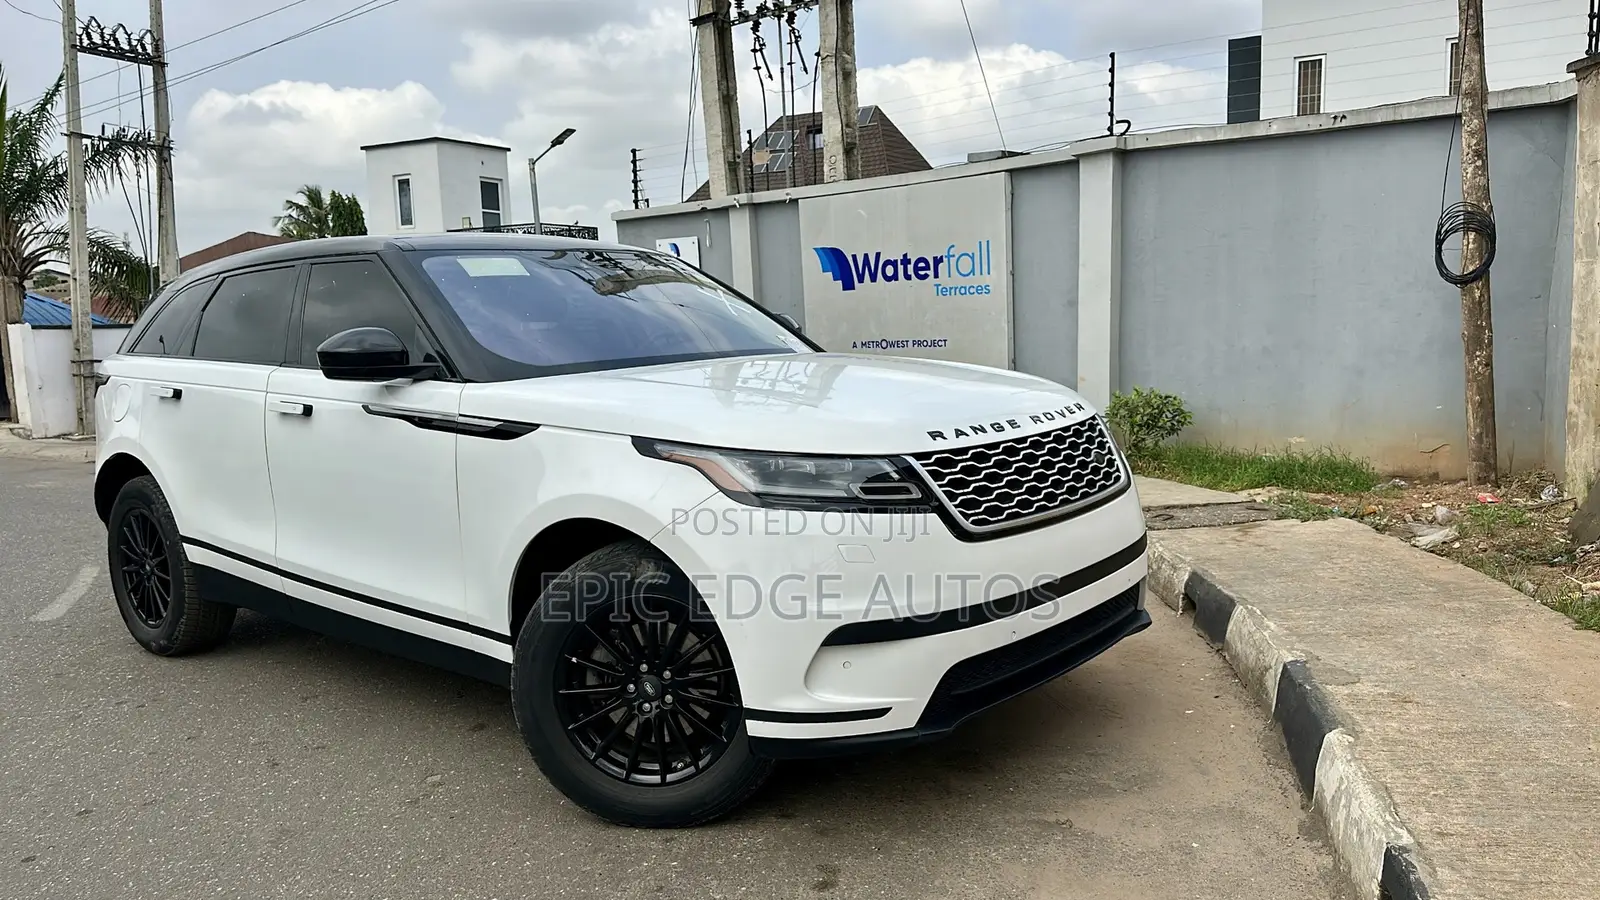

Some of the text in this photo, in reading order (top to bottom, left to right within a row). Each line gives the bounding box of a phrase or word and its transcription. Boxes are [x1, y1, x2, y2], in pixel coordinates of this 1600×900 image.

[851, 240, 991, 284] Waterfall
[934, 284, 991, 297] Terraces
[852, 338, 948, 350] A METROWEST PROJECT
[927, 402, 1086, 441] RANGE ROVER
